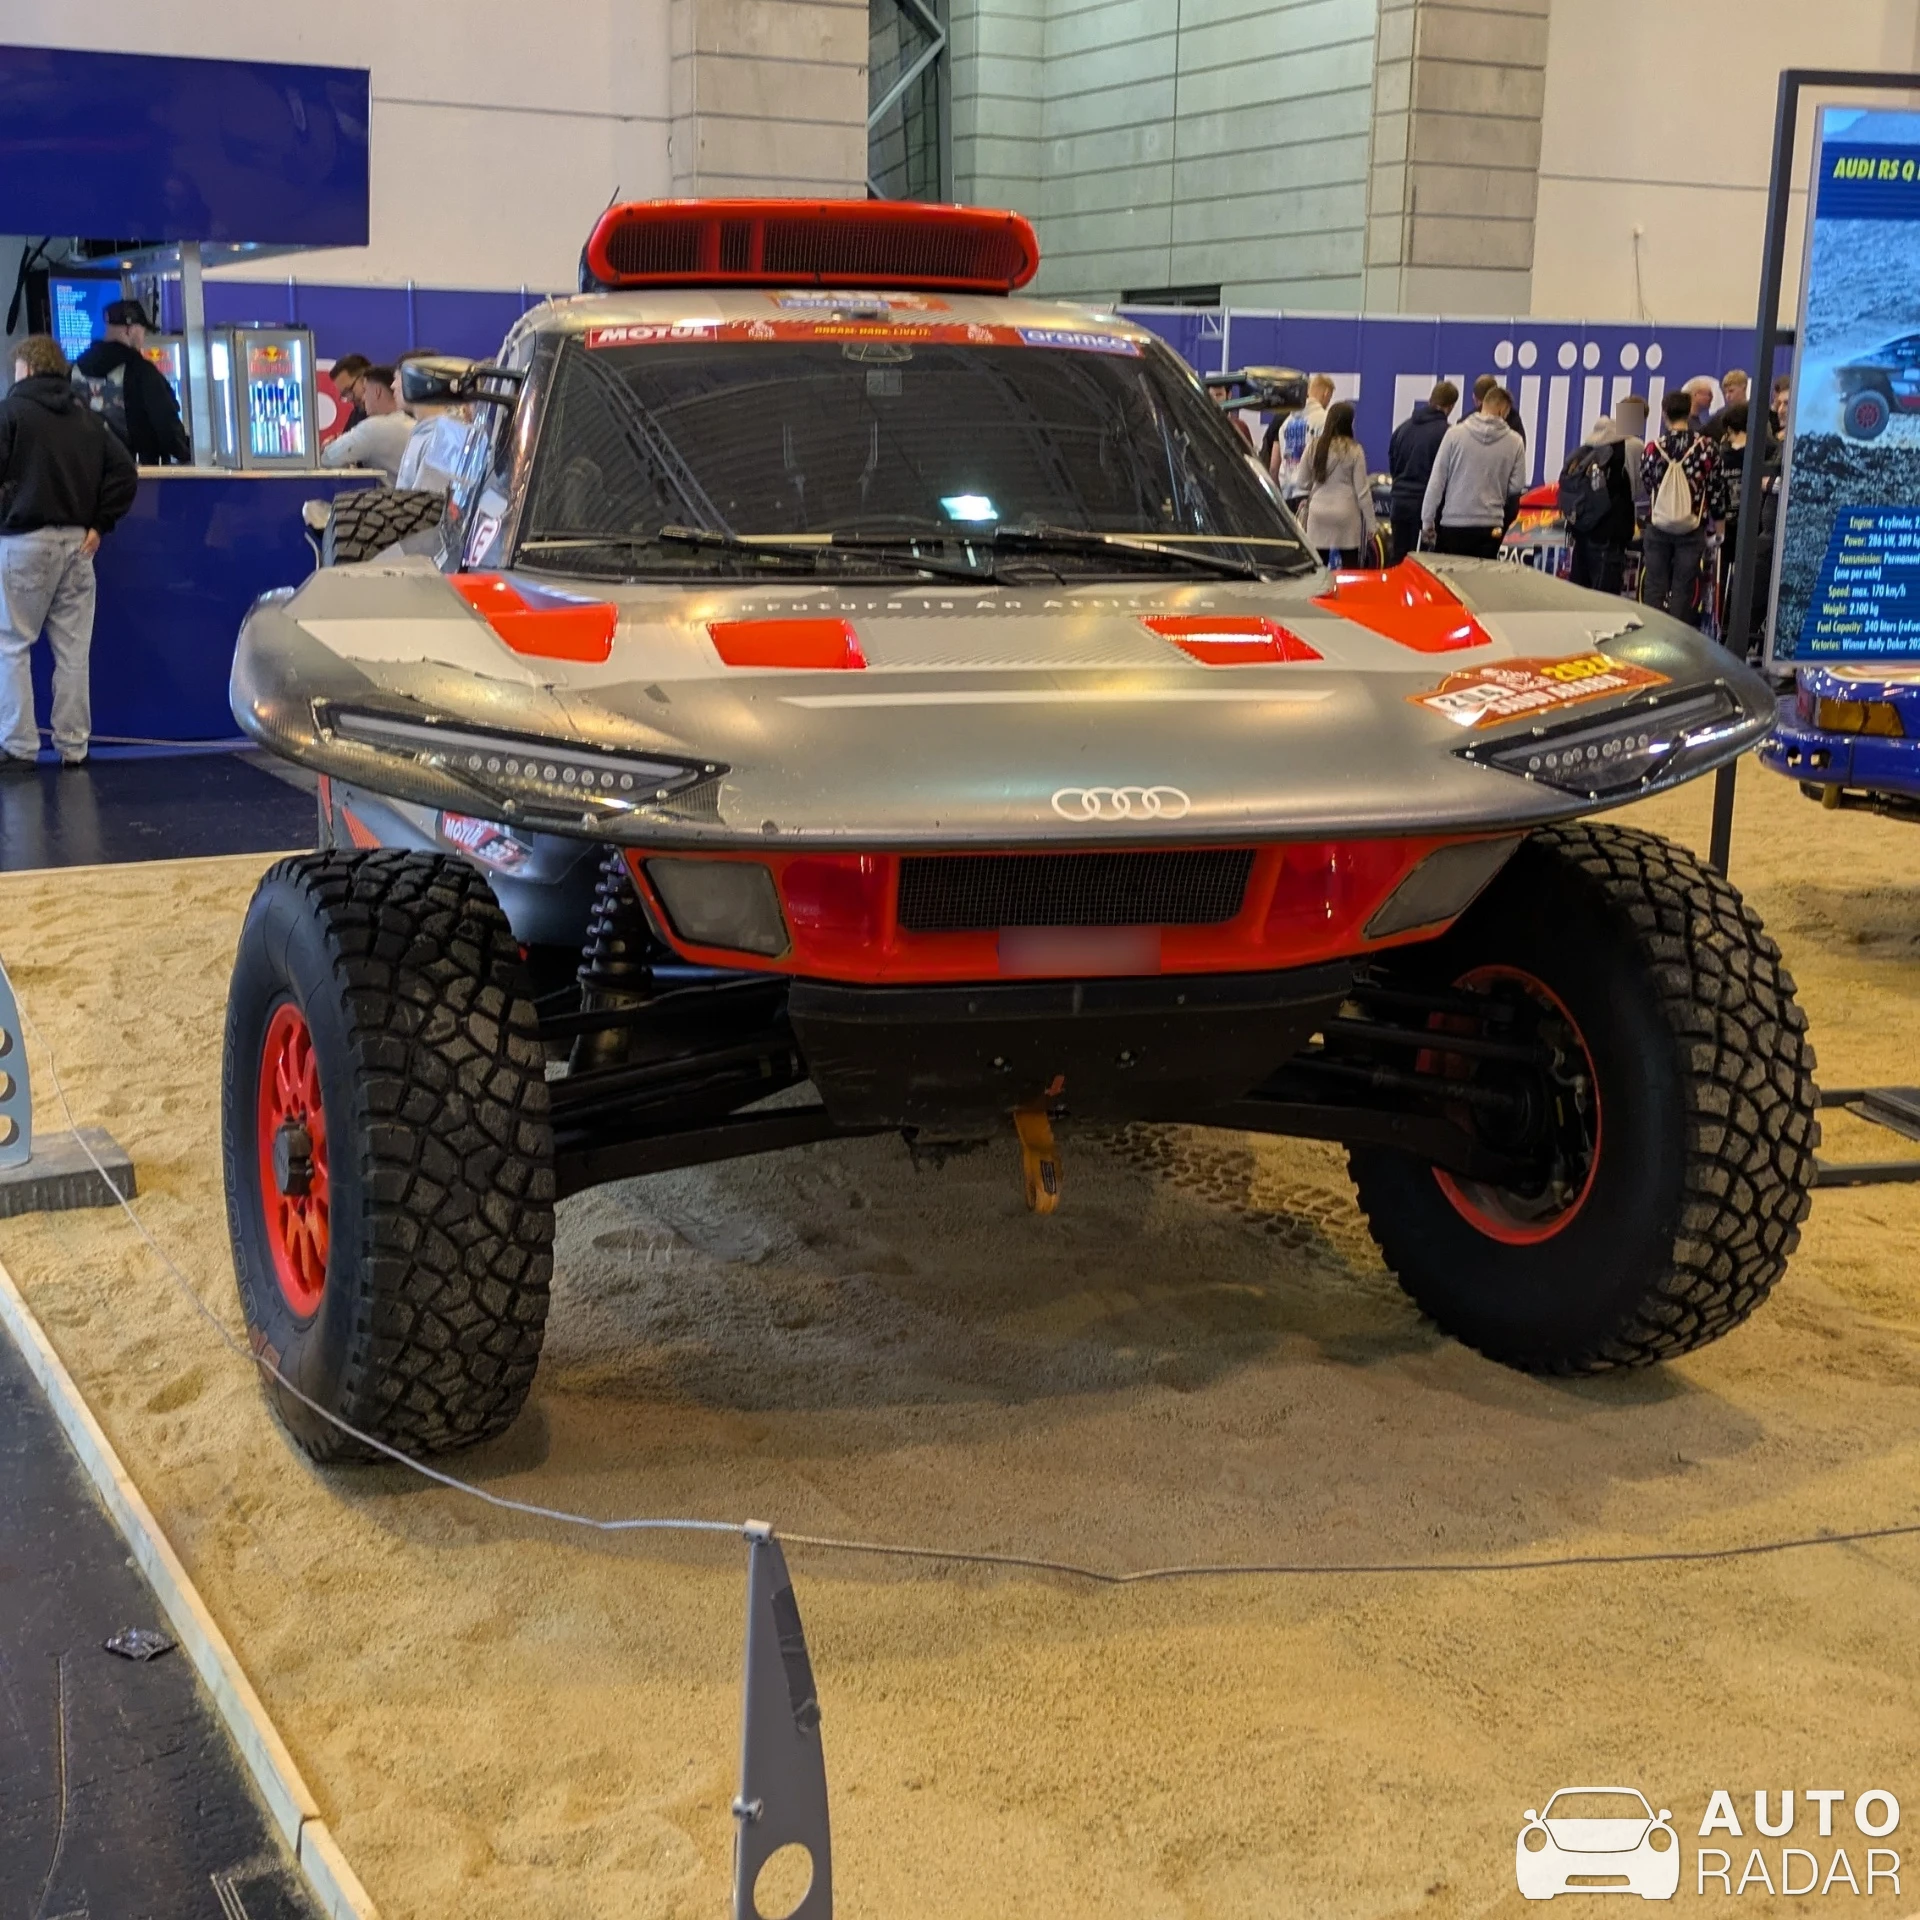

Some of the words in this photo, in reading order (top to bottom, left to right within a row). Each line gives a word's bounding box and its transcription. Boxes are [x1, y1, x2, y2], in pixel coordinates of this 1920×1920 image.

[1833, 157, 1876, 179] AUDI
[1877, 158, 1900, 180] RS
[1902, 159, 1915, 182] Q
[597, 325, 710, 343] MOTUL
[1027, 330, 1128, 350] aramco
[1850, 515, 1875, 531] Engine:
[1844, 534, 1867, 547] Power:
[1834, 565, 1850, 582] (one
[1850, 569, 1863, 582] per
[1864, 565, 1882, 582] axle)
[1828, 583, 1851, 599] Speed:
[1852, 587, 1870, 598] max.
[1872, 584, 1884, 598] 170
[1885, 583, 1906, 600] km/h
[1822, 602, 1848, 618] Weight:
[1849, 602, 1869, 616] 2.100
[1870, 602, 1879, 618] kg
[1817, 620, 1832, 633] Fuel
[1833, 620, 1863, 635] Capacity:
[1864, 620, 1879, 633] 340
[1880, 619, 1897, 633] liters
[1811, 638, 1840, 651] Victories:
[1842, 638, 1867, 651] Winner
[1868, 637, 1886, 652] Rally
[1886, 637, 1908, 651] Dakar
